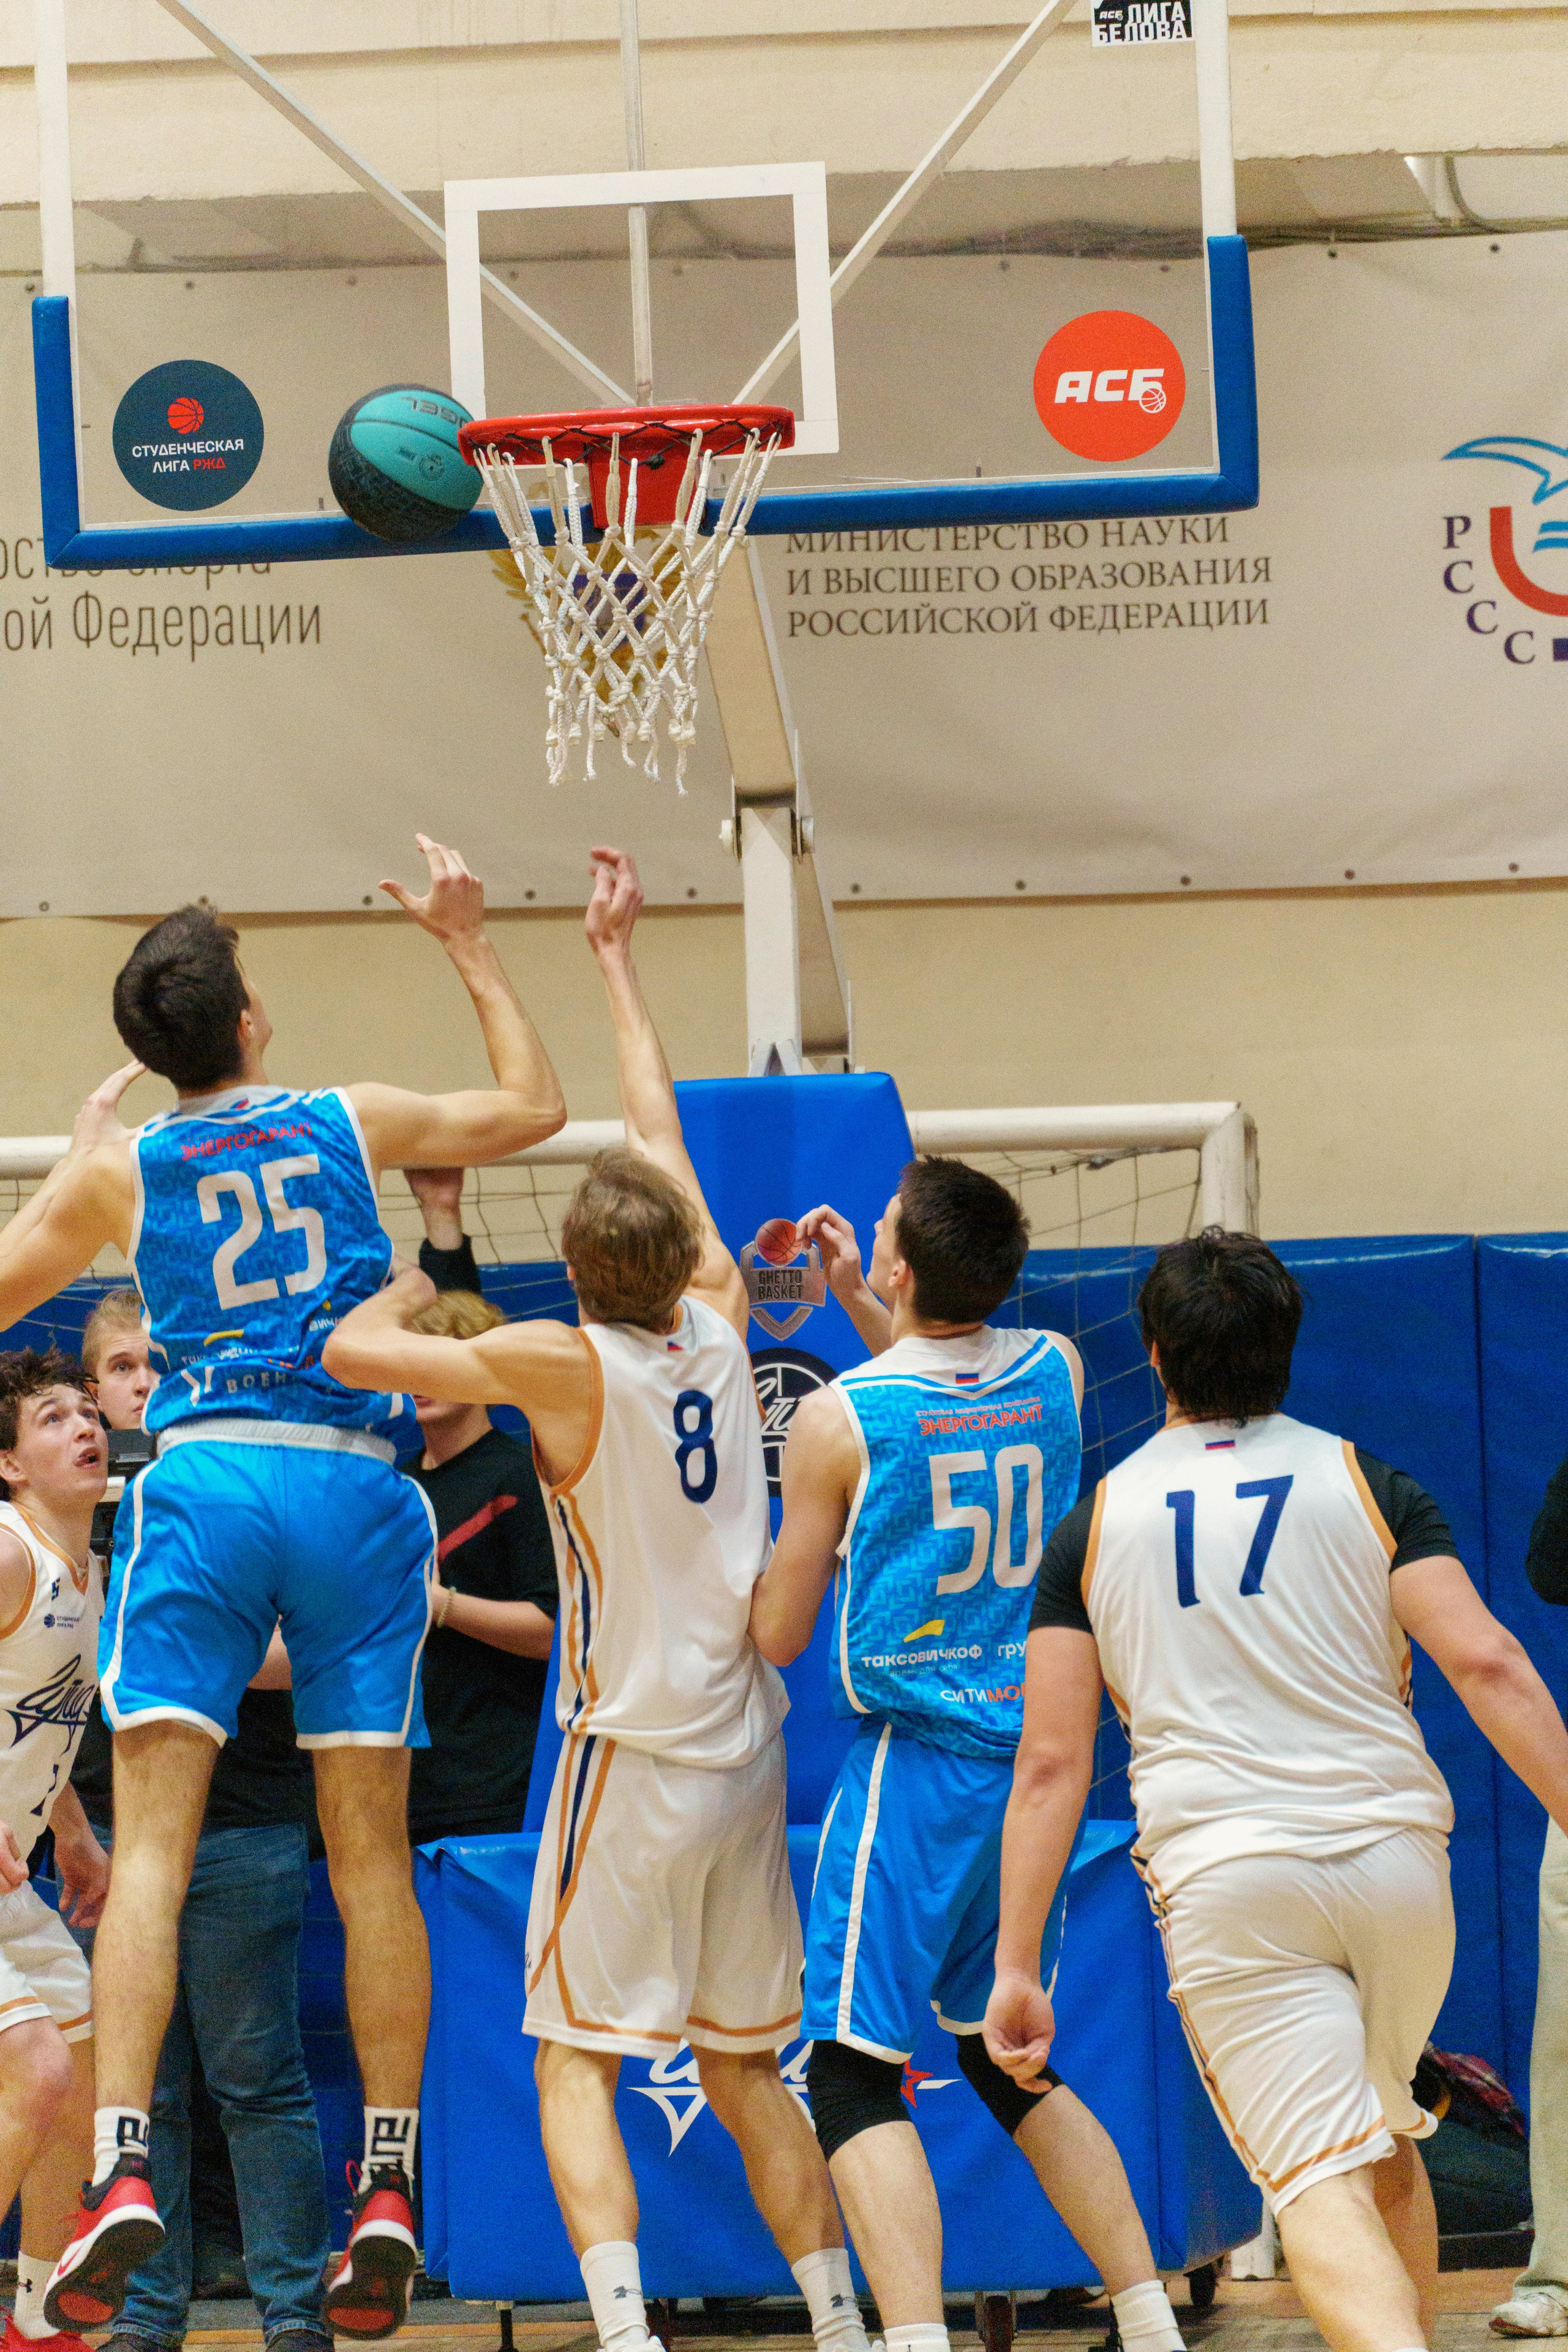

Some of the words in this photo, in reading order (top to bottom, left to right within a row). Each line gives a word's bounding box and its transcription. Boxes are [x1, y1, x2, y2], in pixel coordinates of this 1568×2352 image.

[1128, 2, 1186, 24] ЛИГА
[1094, 20, 1189, 42] БЕЛОВА
[1054, 368, 1166, 410] АСБ
[132, 438, 244, 458] СТУДЕНЧЕСКАЯ
[153, 460, 190, 473] ЛИГА
[192, 457, 226, 470] РЖД
[786, 523, 1089, 553] МИНИСТЕРСТВО
[1101, 516, 1231, 548] НАУКИ
[787, 568, 812, 595] И
[824, 565, 1000, 595] ВЫСШЕГО
[1011, 556, 1272, 592] ОБРАЗОВАНИЯ
[4, 595, 53, 651] ой
[73, 590, 321, 662] Федерации
[788, 600, 1039, 637] РОССИЙСКОЙ
[1049, 598, 1269, 635] ФЕДЕРАЦИИ
[196, 1153, 328, 1311] 25
[758, 1269, 802, 1284] GHETTO
[758, 1284, 803, 1300] BASKET
[226, 1371, 287, 1394] ВОЕН
[918, 1404, 1042, 1436] ЭНЕРГОГАРАНТ
[673, 1389, 718, 1505] 8
[929, 1442, 1044, 1596] 50
[1166, 1474, 1294, 1608] 17
[997, 1640, 1027, 1659] гру
